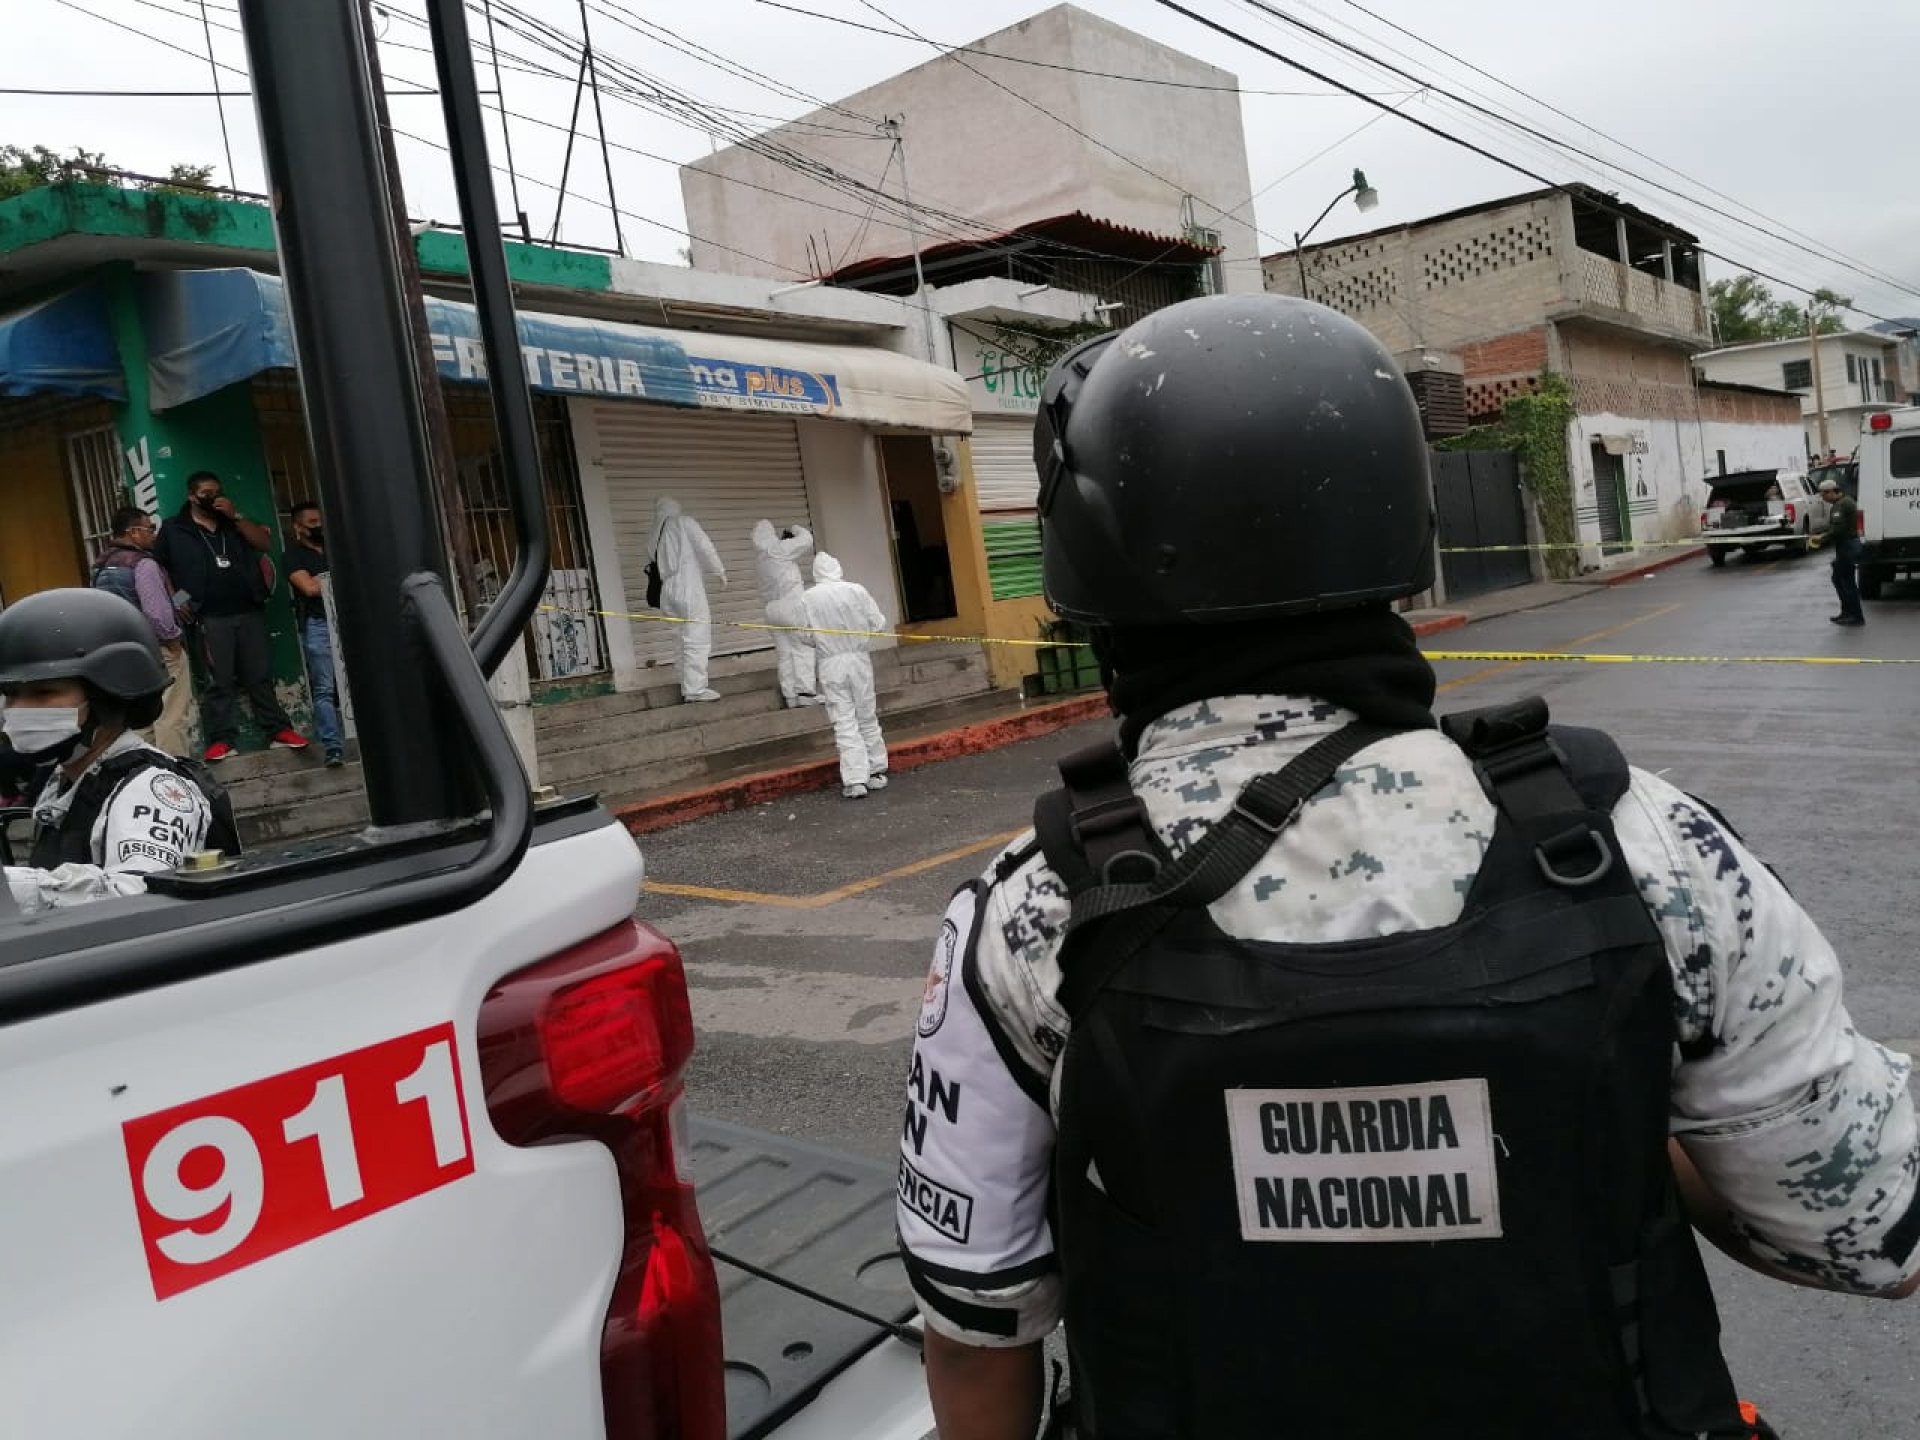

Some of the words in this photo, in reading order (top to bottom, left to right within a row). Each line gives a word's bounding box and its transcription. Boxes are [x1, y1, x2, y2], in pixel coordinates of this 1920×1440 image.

[745, 367, 805, 396] plus
[133, 804, 193, 847] PLAN
[149, 826, 184, 852] GN
[1259, 1094, 1459, 1155] GUARDIA
[142, 1039, 468, 1266] 911
[1254, 1172, 1482, 1229] NACIONAL
